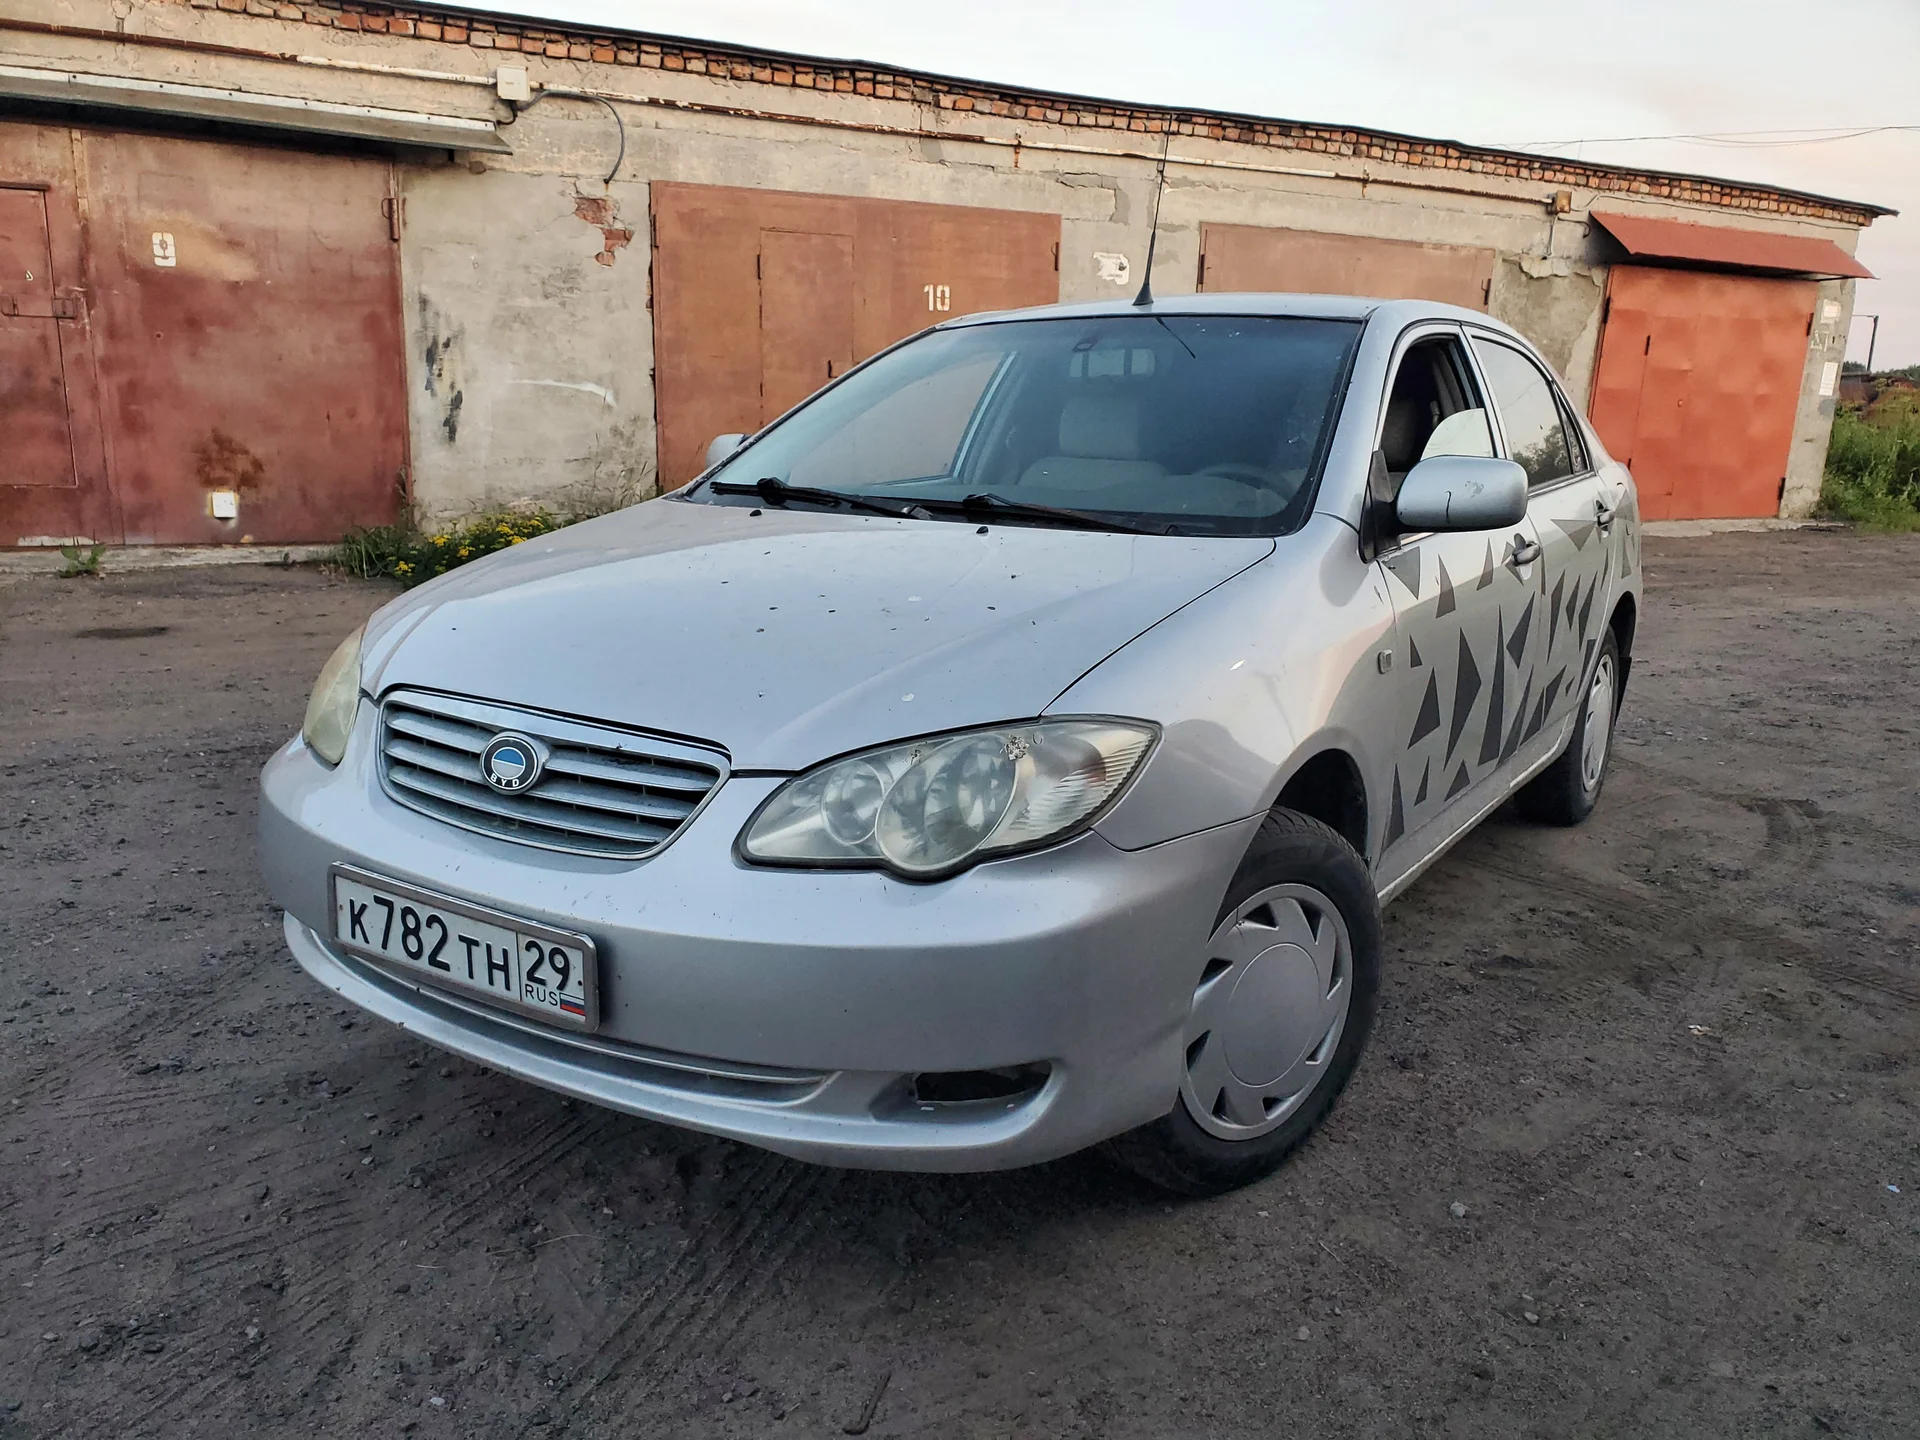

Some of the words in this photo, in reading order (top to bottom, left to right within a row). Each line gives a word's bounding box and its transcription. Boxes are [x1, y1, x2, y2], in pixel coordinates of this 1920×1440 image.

[923, 284, 951, 312] 10
[491, 773, 519, 787] BYD
[524, 940, 570, 991] 29
[524, 984, 559, 1007] RUS
